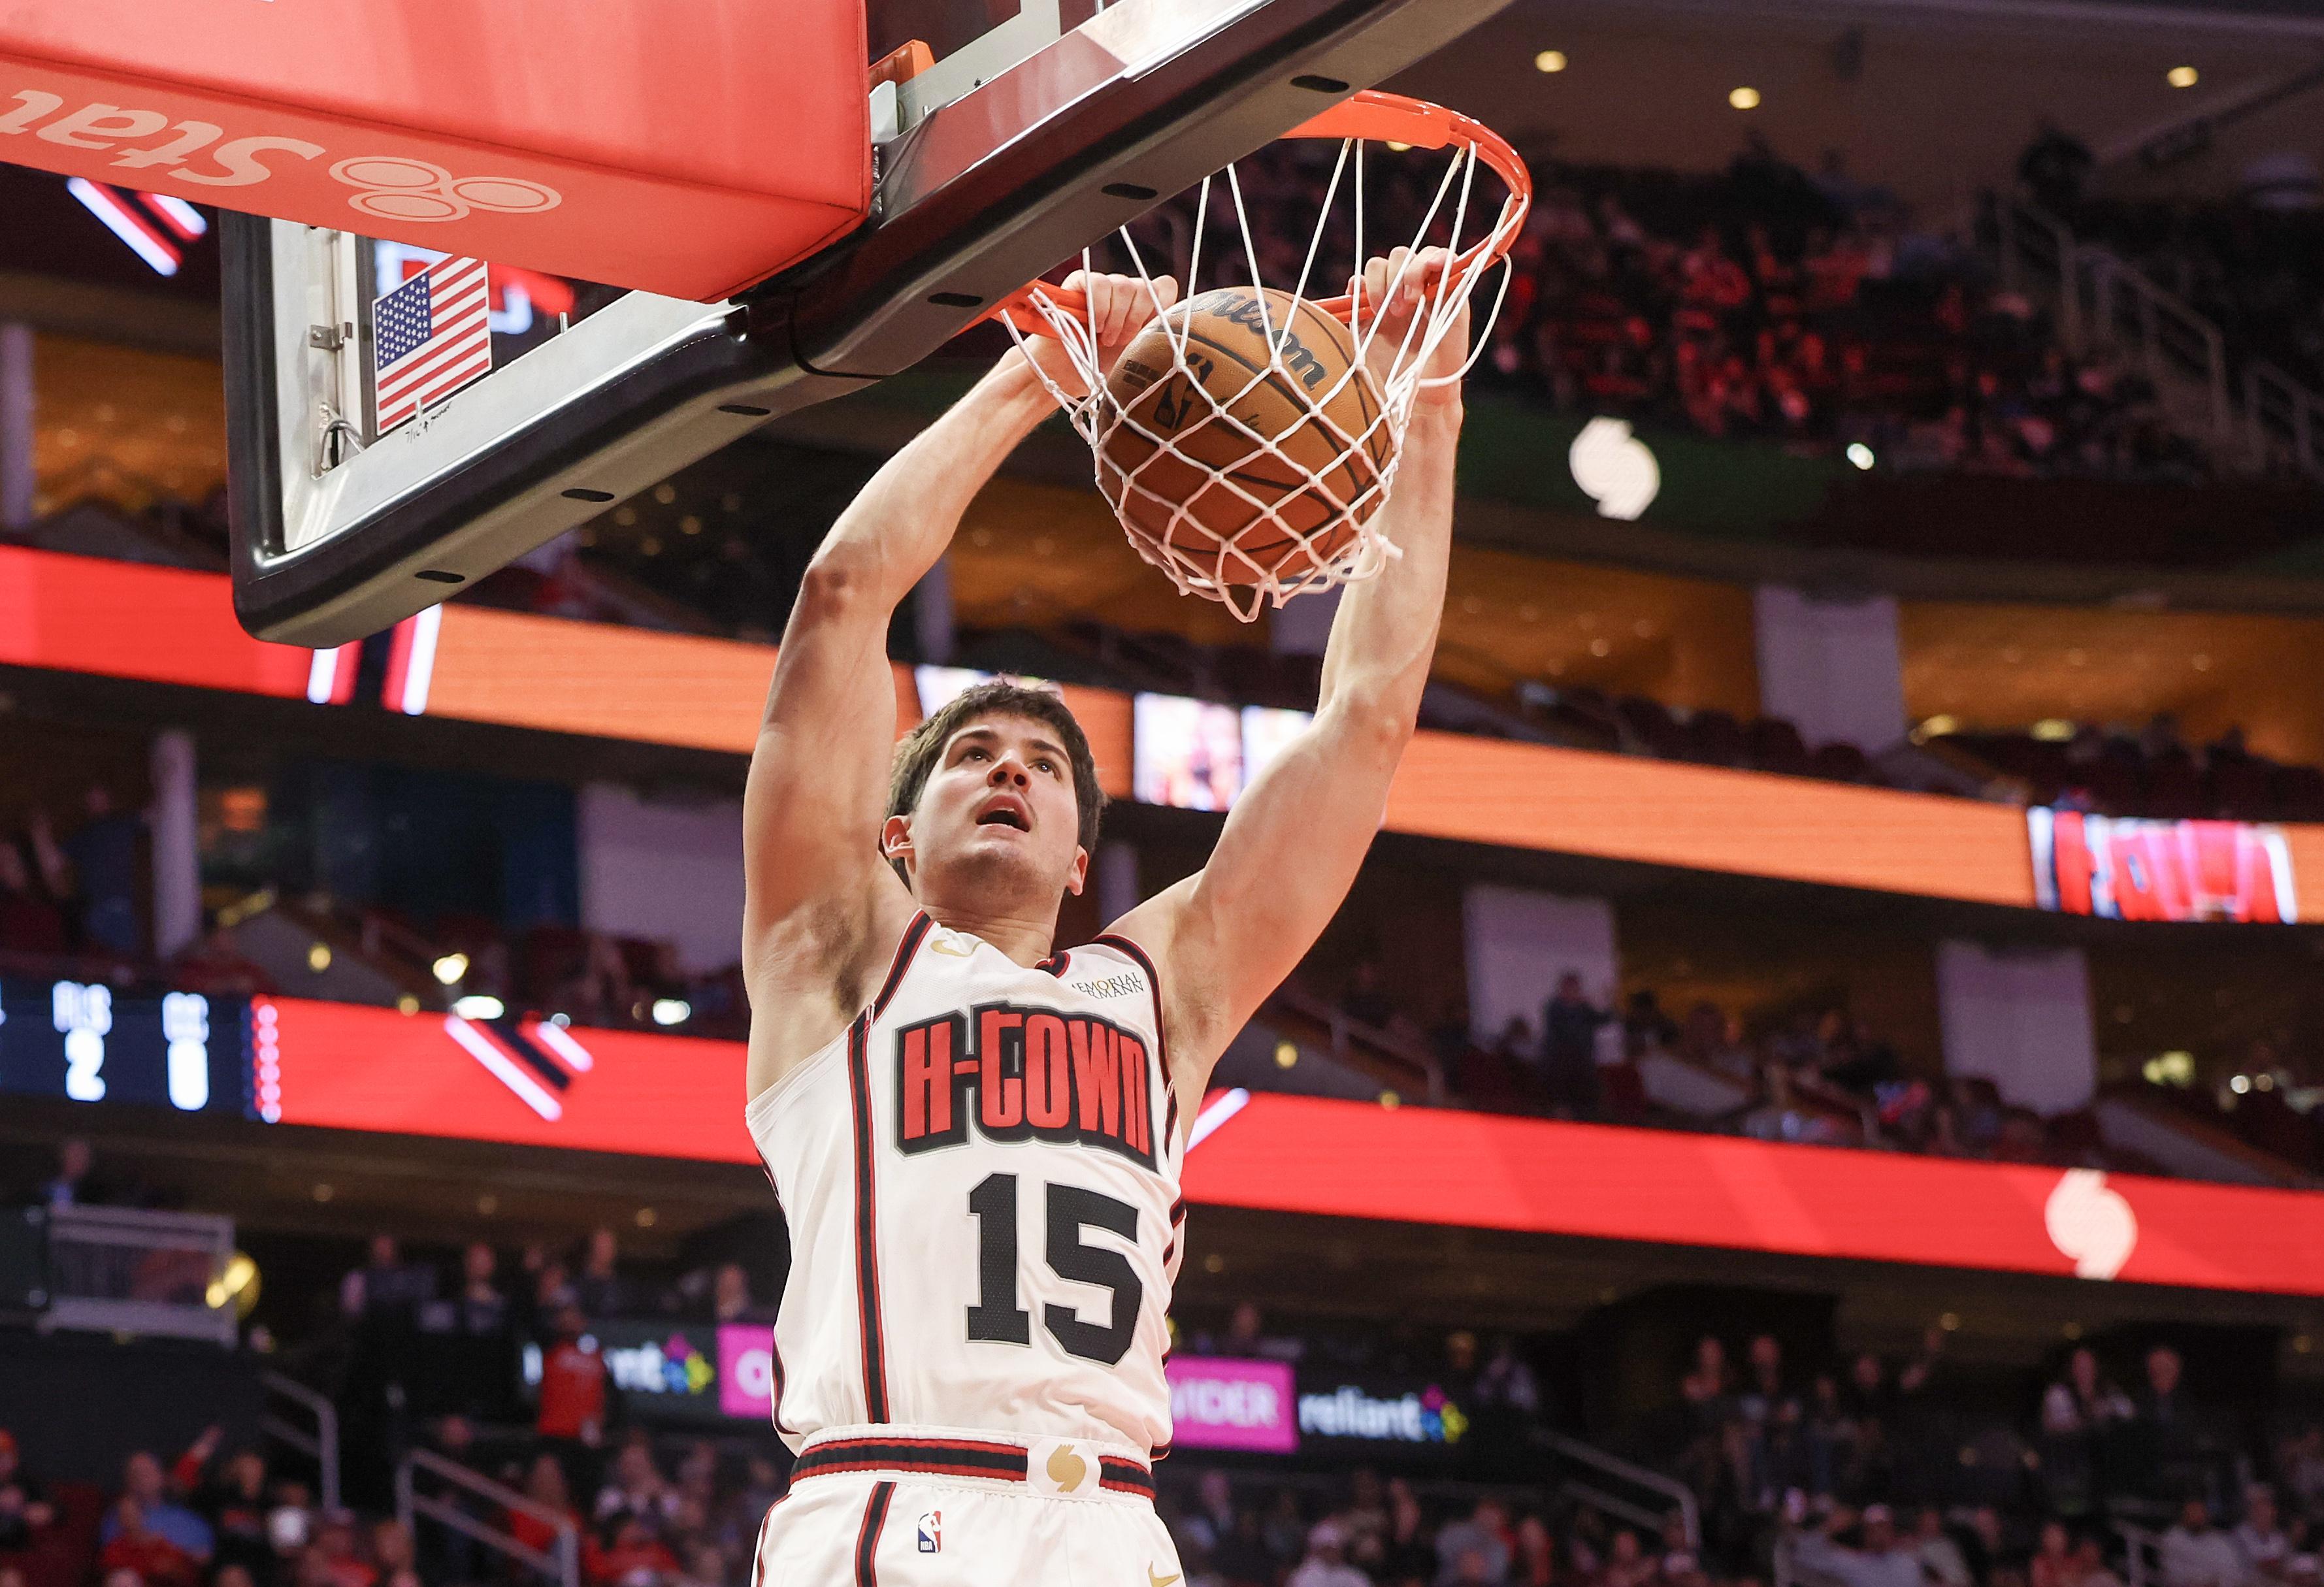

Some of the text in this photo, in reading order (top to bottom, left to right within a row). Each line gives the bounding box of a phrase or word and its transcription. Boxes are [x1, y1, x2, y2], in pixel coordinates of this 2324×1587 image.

[1072, 972, 1141, 992] EMORIAL
[965, 1171, 1144, 1368] 15
[920, 1541, 933, 1550] NBA
